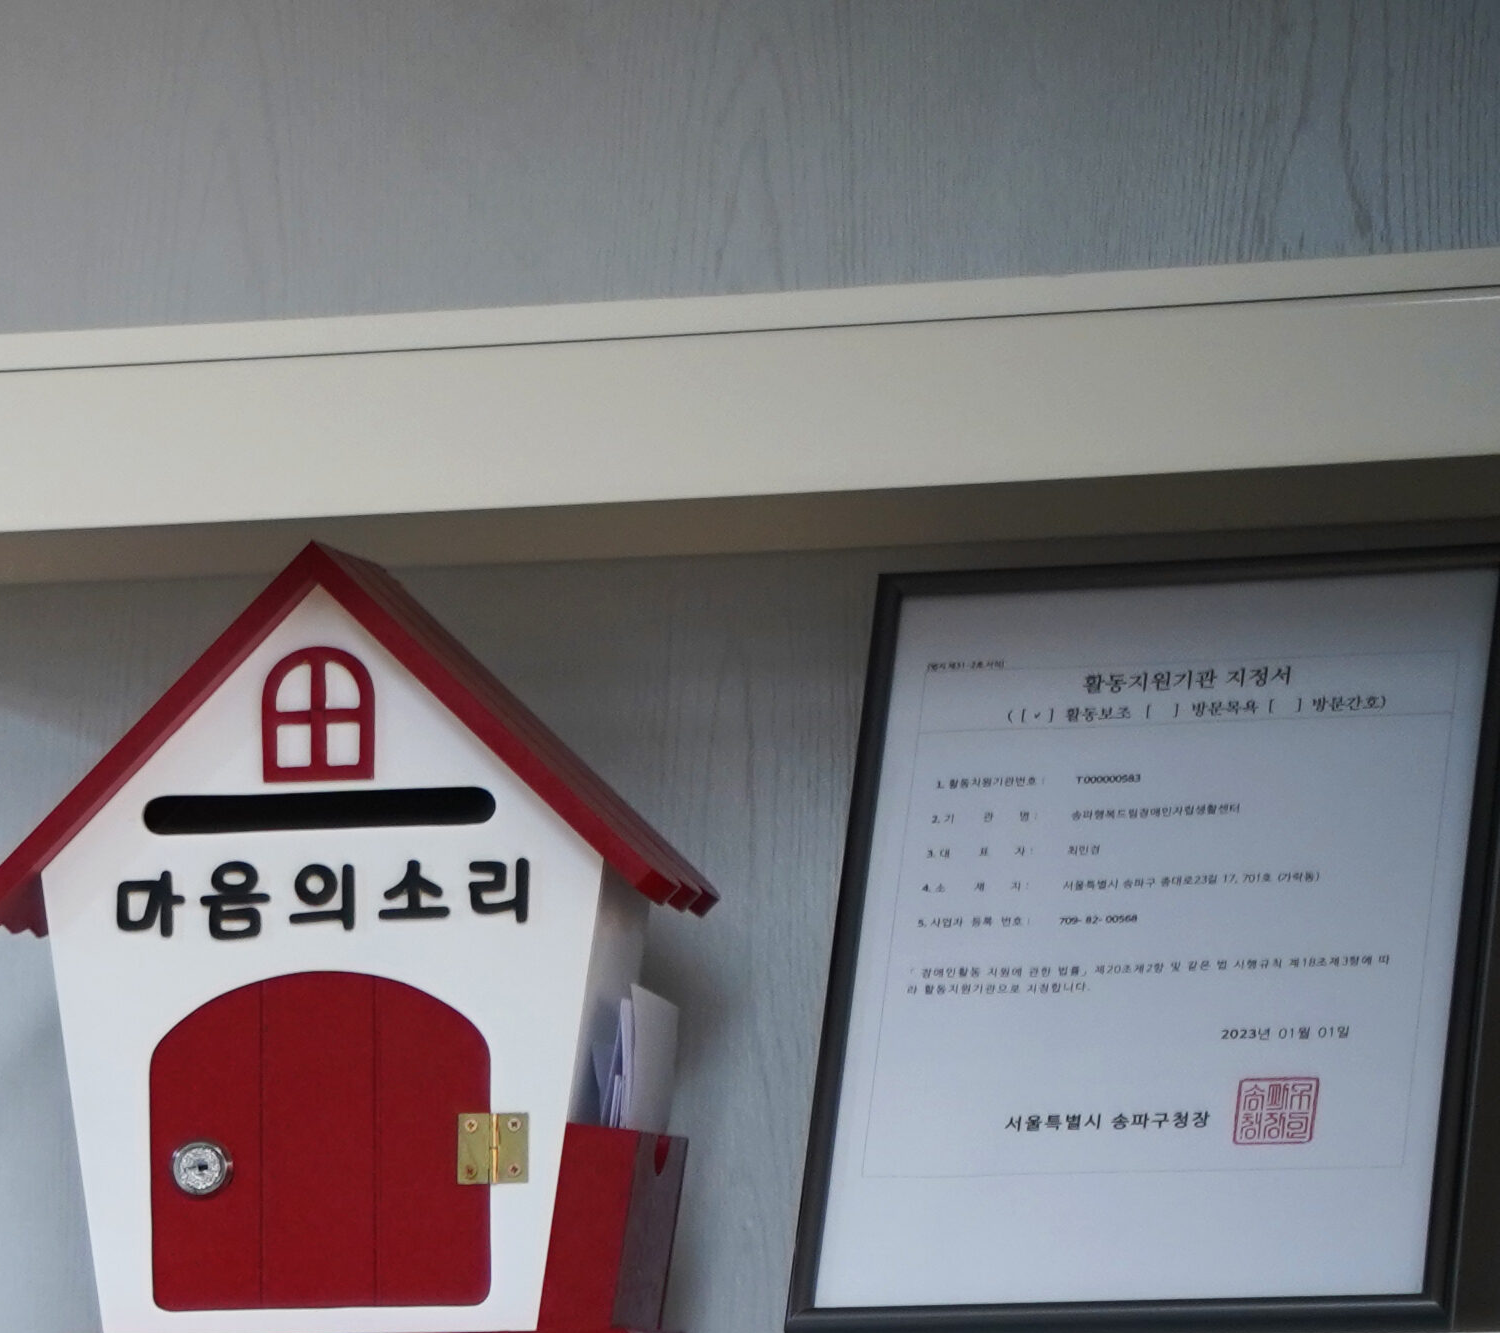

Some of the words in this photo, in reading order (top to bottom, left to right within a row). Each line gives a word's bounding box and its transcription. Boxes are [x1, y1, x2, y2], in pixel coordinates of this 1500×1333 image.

[1082, 668, 1217, 694] 활동지원기관
[1227, 665, 1292, 689] 지정서
[1221, 1028, 1271, 1041] 2023년
[1278, 1026, 1311, 1040] 01월
[1318, 1025, 1350, 1039] 01일
[1004, 1112, 1102, 1132] 서울특별시
[1110, 1110, 1211, 1130] 송파구청장
